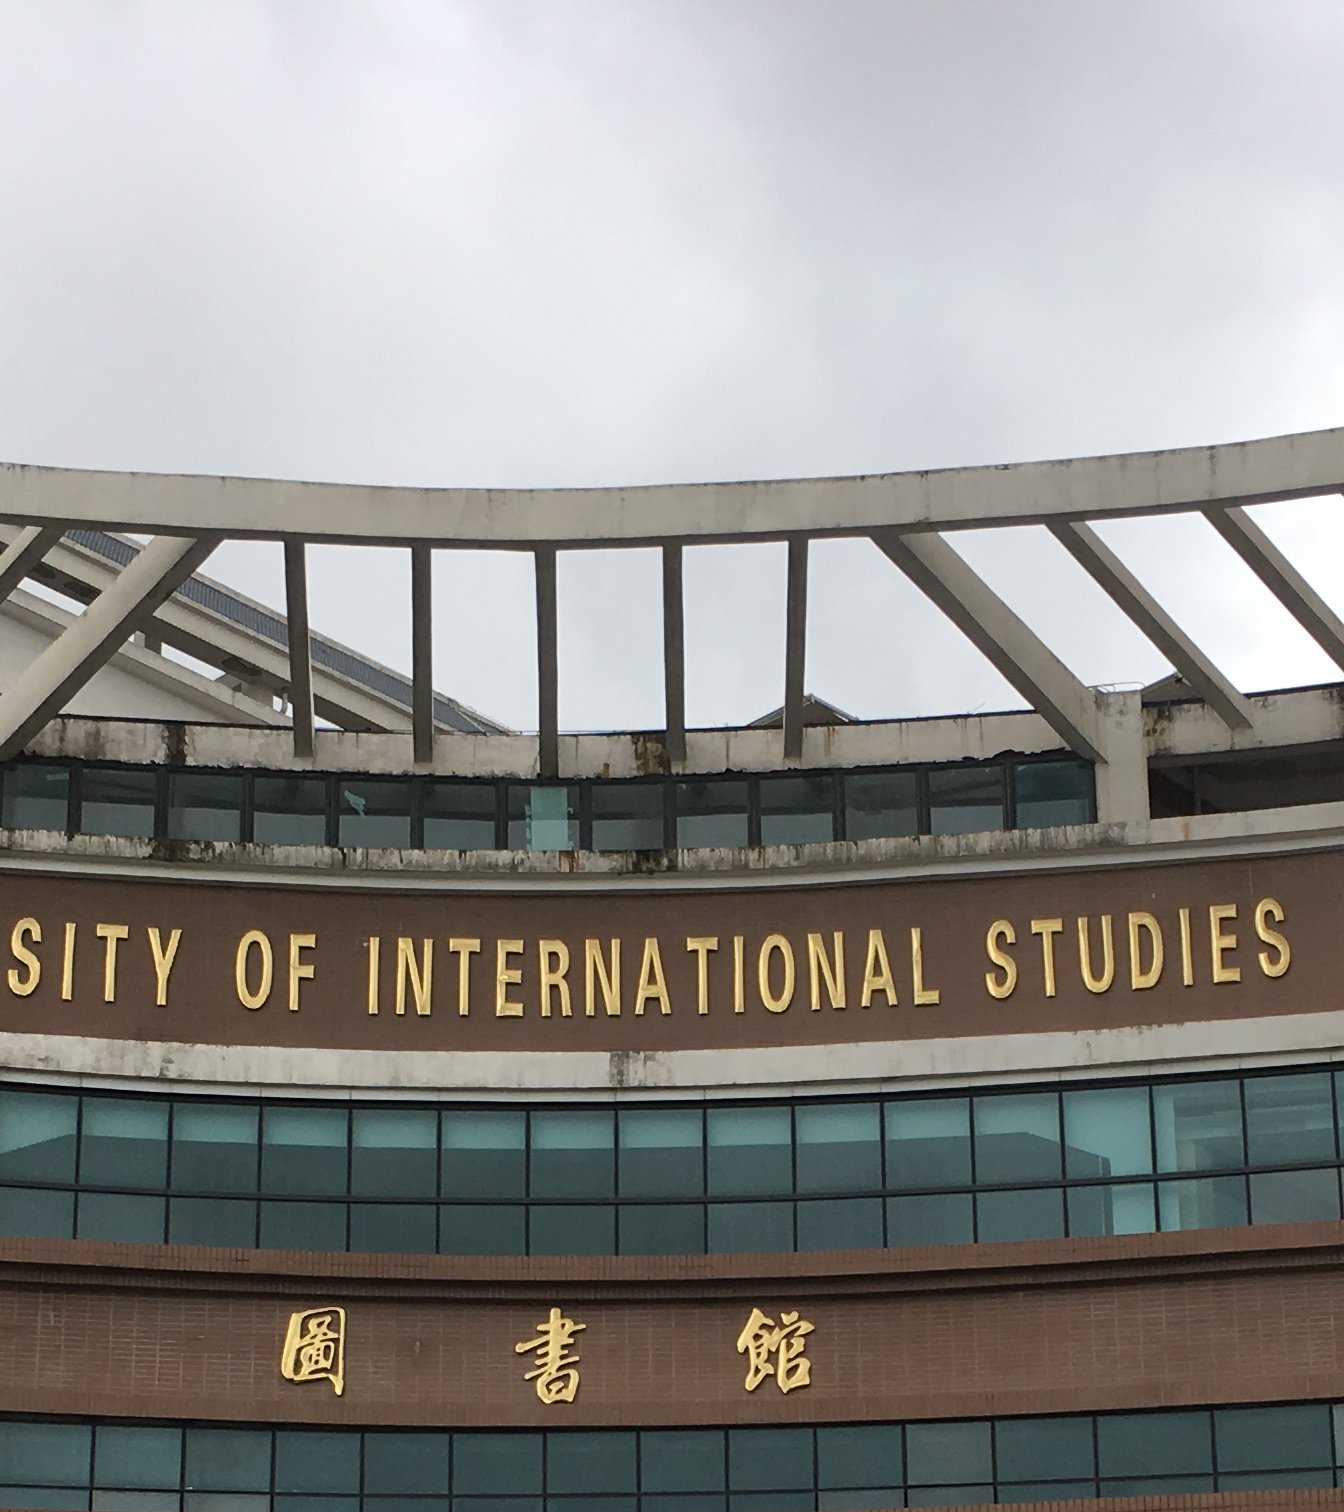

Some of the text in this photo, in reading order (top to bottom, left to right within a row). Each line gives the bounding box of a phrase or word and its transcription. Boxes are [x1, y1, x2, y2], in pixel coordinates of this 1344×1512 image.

[235, 929, 318, 1011] OF
[367, 926, 941, 1017] INTERNATIONAL
[985, 897, 1292, 999] STUDIES
[280, 1306, 816, 1405] 圖書館
